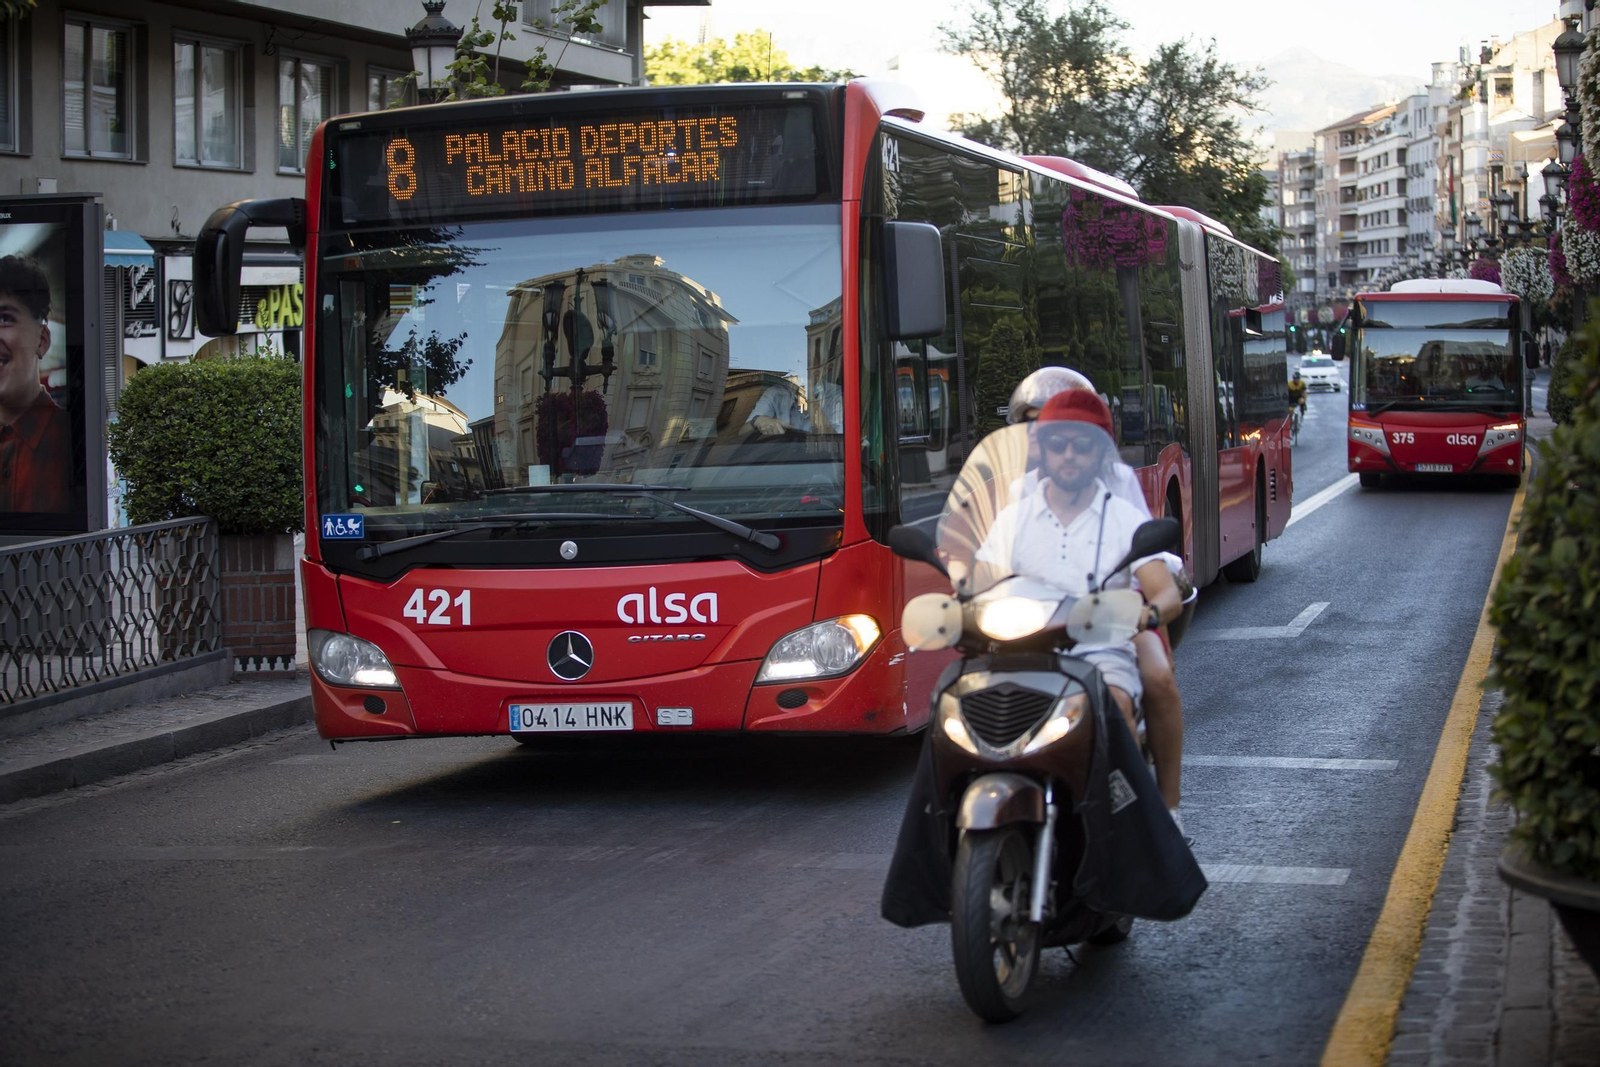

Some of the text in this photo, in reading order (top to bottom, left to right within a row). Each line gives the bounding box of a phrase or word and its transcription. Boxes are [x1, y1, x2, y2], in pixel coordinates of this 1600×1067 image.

[446, 116, 738, 164] PALACIO DEPORTES
[882, 137, 900, 172] 421
[386, 138, 417, 200] 8
[466, 151, 720, 195] CAMINO ALFACAR
[1392, 432, 1476, 445] 375 alsa
[403, 586, 718, 625] 421 alsa
[627, 633, 706, 643] CITARO
[522, 706, 627, 728] 0414 HNK
